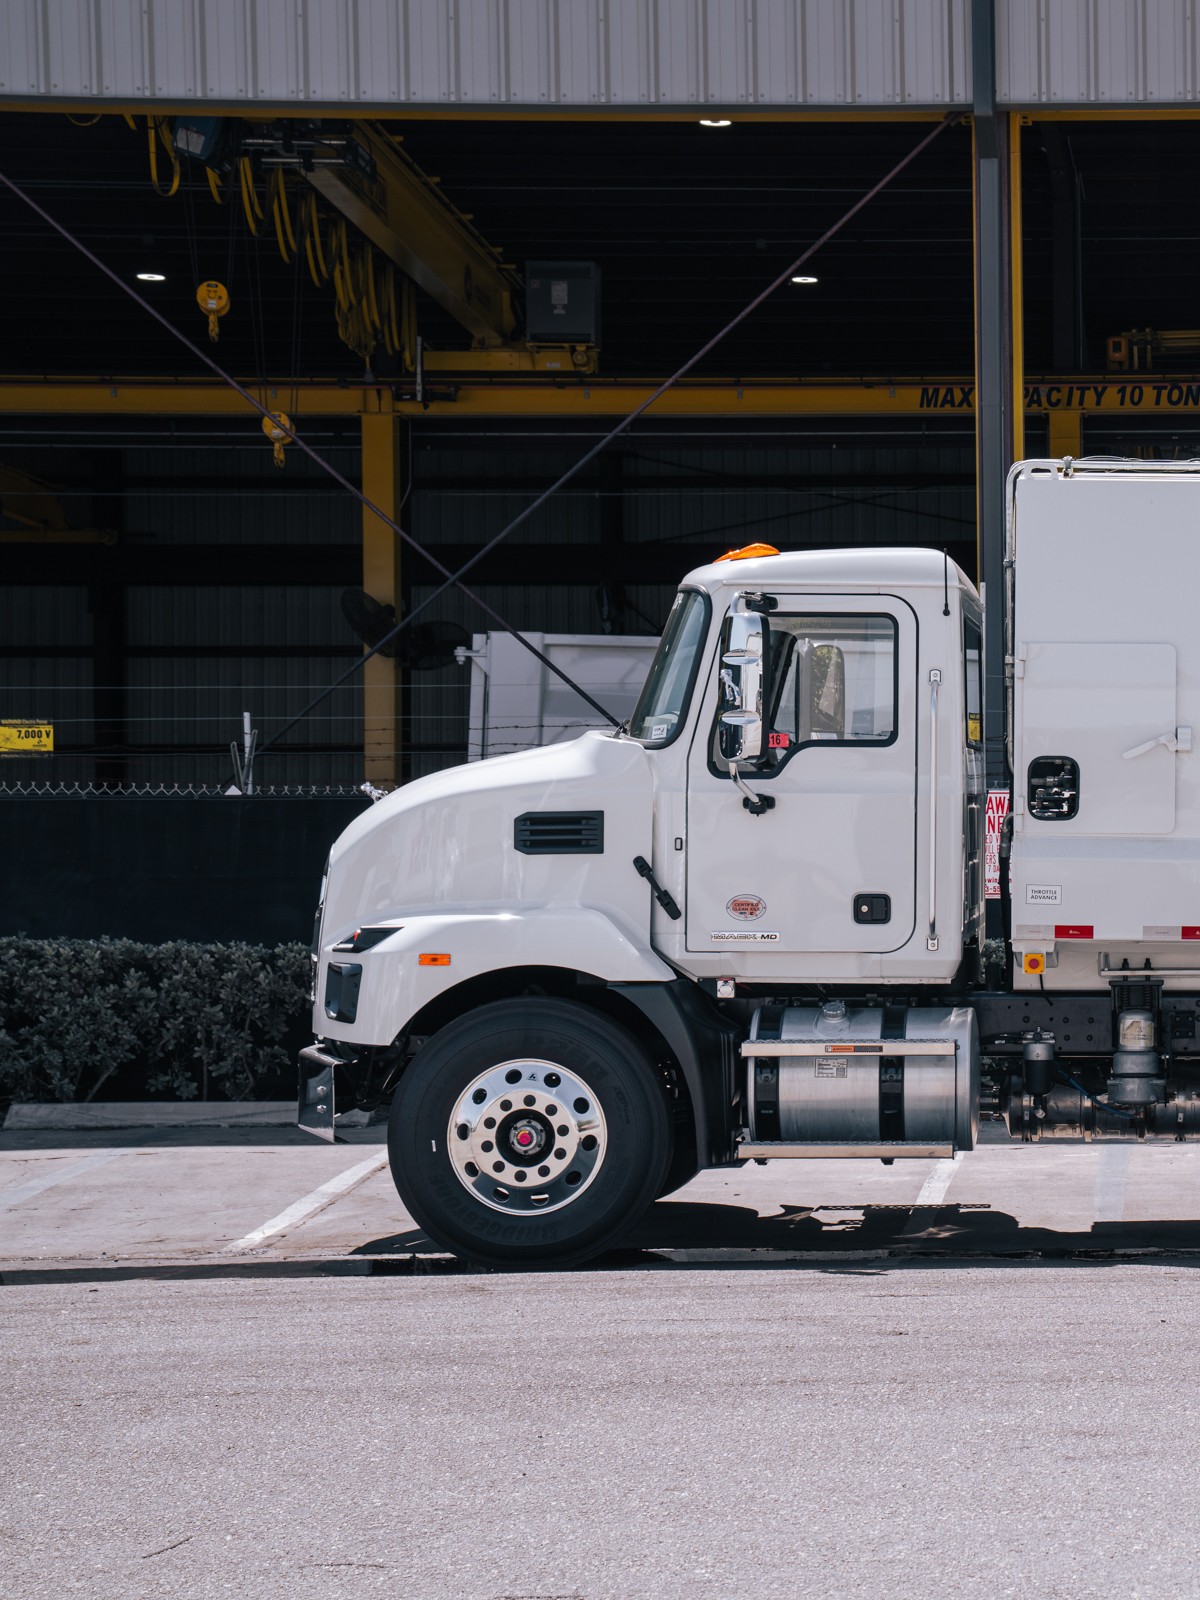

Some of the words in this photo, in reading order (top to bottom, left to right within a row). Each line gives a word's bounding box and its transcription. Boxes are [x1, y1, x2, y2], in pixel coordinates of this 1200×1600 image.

[919, 386, 975, 408] MAX
[1116, 385, 1143, 406] 10
[1152, 384, 1200, 406] TON
[17, 730, 42, 740] 7,000
[45, 730, 51, 738] V
[770, 734, 780, 745] 16
